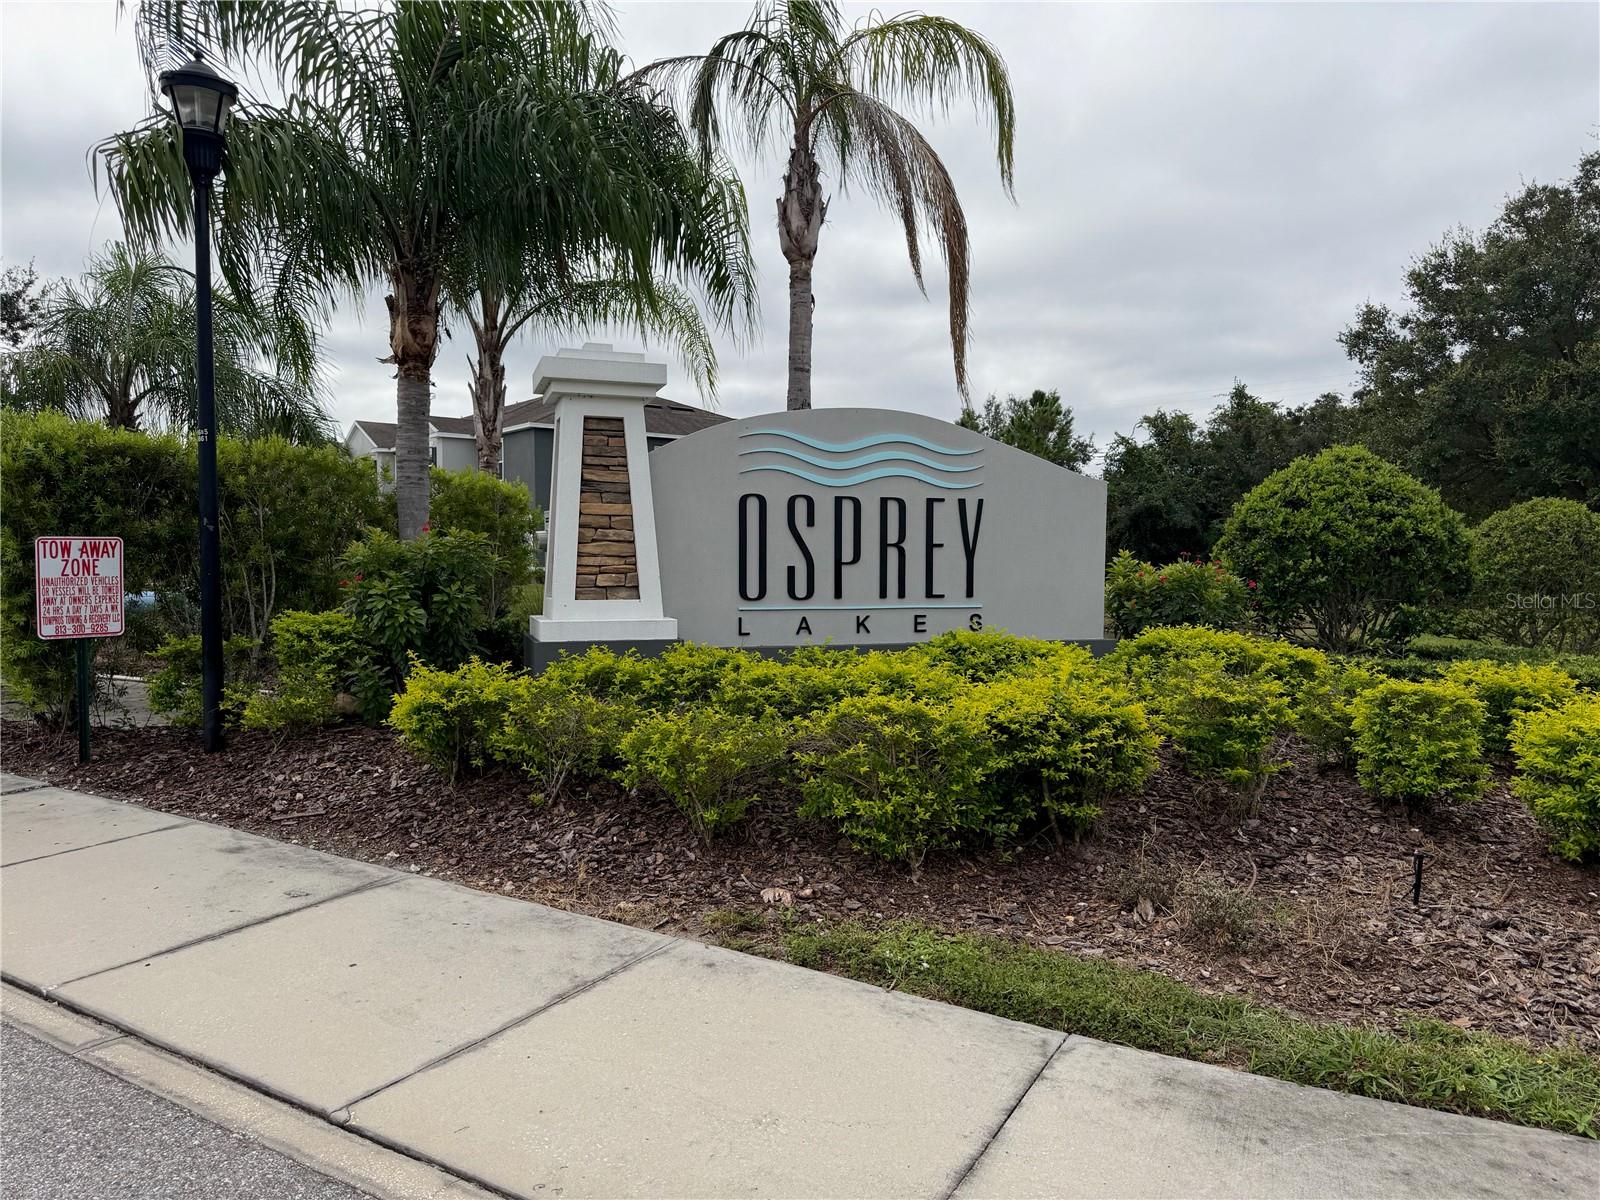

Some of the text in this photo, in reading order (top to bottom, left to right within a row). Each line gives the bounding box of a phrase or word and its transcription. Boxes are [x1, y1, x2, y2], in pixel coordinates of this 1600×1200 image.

[41, 541, 118, 559] TOW AWAY
[739, 493, 983, 601] OSPREY
[61, 559, 100, 576] ZONE
[42, 576, 118, 586] UNAUTHORIZED VEHICLES
[42, 586, 119, 596] OR VESSELS WILL BE TOWED
[42, 595, 119, 606] AWAY AT OWNERS EXPENSE
[43, 604, 118, 615] 24 HRS A DAY 7 DAYS A WK
[42, 613, 120, 625] TOWPROS TOWING & RECOVERY LLC
[738, 613, 983, 637] LAKES
